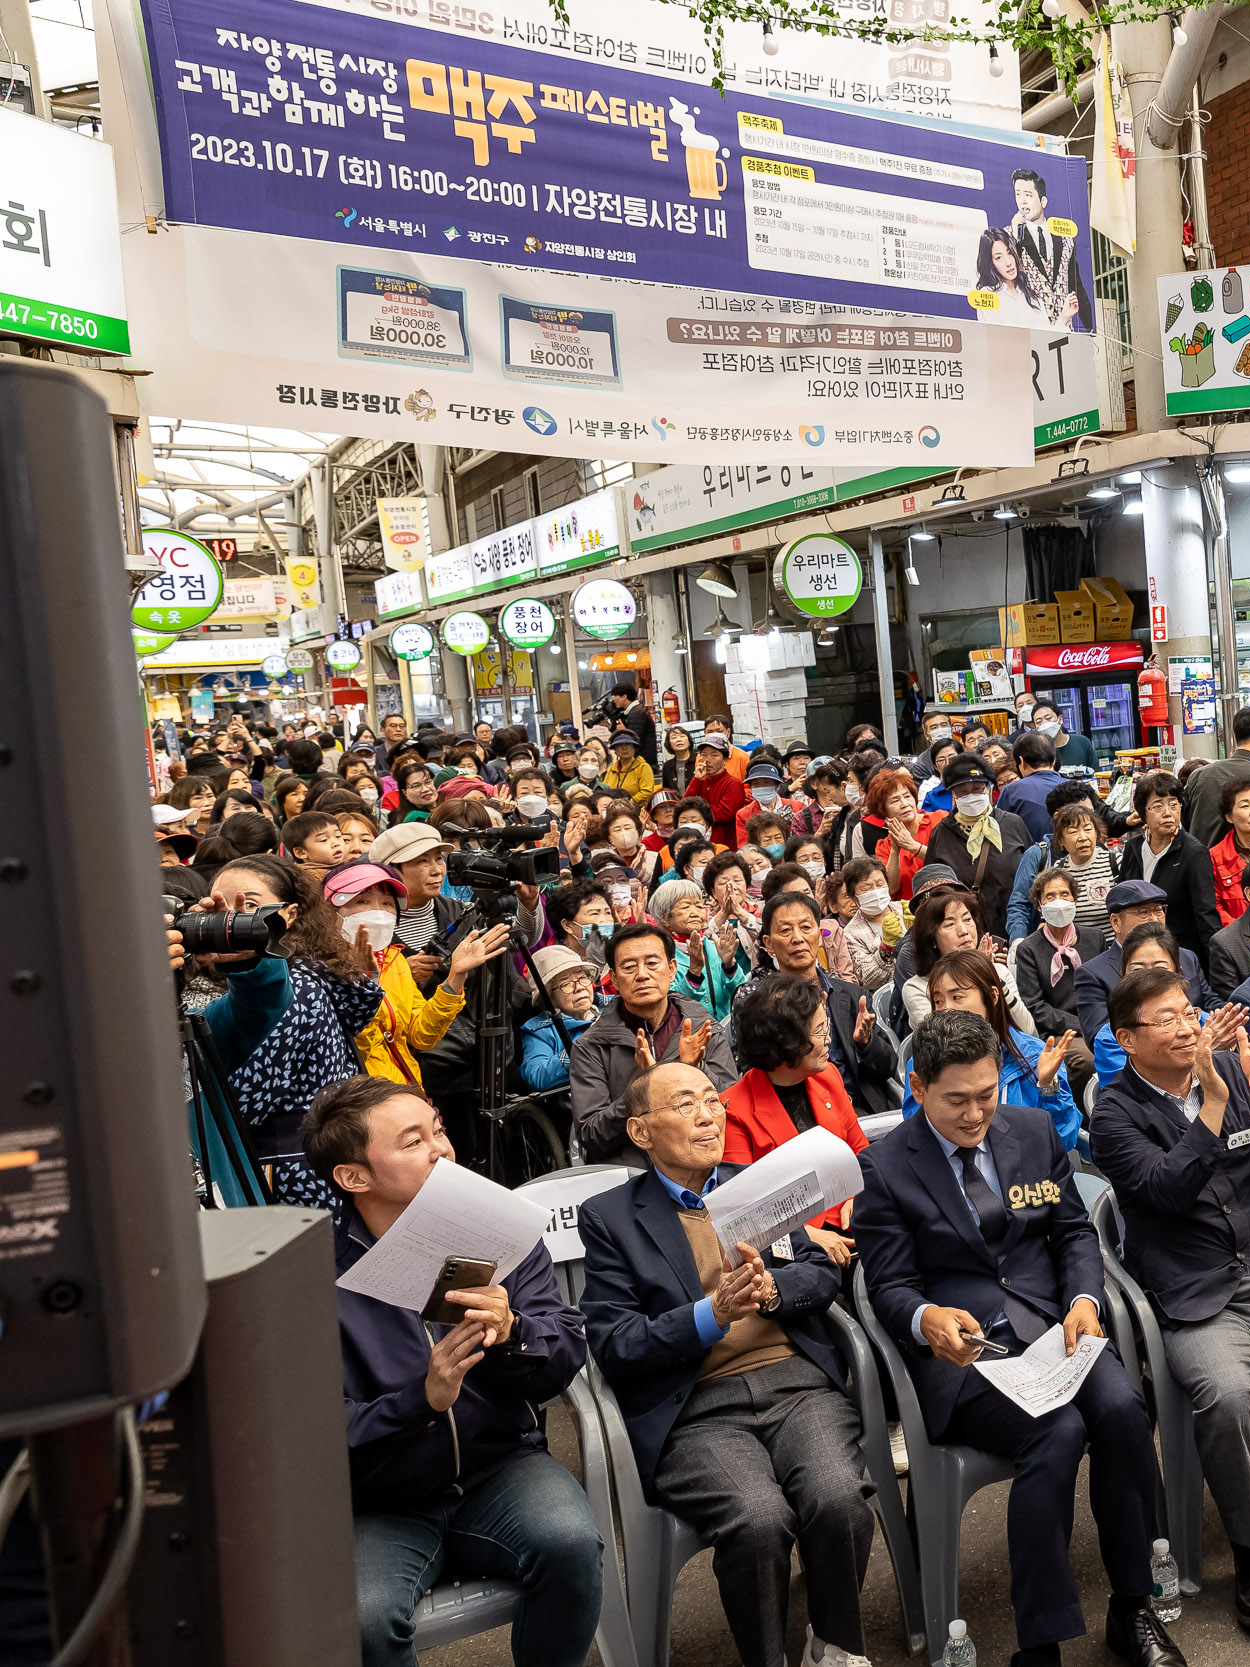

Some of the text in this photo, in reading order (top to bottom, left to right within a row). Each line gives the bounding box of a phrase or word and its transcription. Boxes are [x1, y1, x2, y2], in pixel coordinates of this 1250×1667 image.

[215, 28, 398, 96] 자양 전통 시장
[174, 59, 406, 142] 고객과 함께 하는
[405, 58, 669, 167] 맥주 페스티벌
[743, 115, 778, 132] 맥주축제
[744, 133, 775, 148] 행사기간
[776, 139, 784, 149] 내
[785, 141, 800, 153] 시장
[801, 143, 833, 159] 1만원이상
[879, 157, 903, 171] 맥주1잔
[903, 162, 918, 173] 무료
[919, 165, 933, 176] 증정
[746, 159, 810, 180] 경품추첨 이벤트
[190, 133, 727, 239] 2023.10.17 (화) 16:00~20:00 자양전통시장 내
[751, 178, 781, 192] 응모 방법
[752, 189, 780, 202] 행사기간
[780, 193, 788, 204] 내
[789, 195, 797, 204] 각
[797, 196, 824, 209] 점포에서
[824, 200, 855, 214] 3만원이상
[855, 205, 874, 216] 구매시
[905, 214, 918, 224] 증정
[753, 205, 782, 218] 응모 기간
[0, 200, 51, 267] 회
[358, 216, 427, 239] 서울특별시
[466, 230, 510, 246] 광진구
[753, 217, 776, 229] 2023년
[777, 220, 791, 231] 10월
[791, 222, 805, 233] 15일
[812, 225, 825, 236] 10월
[826, 227, 839, 238] 17일
[860, 232, 873, 242] 까지
[755, 233, 769, 243] 추첨
[882, 225, 907, 237] 경품안내
[544, 240, 637, 264] 자양전통시장 상인회
[755, 244, 778, 256] 2023년
[779, 247, 792, 257] 10월
[793, 249, 806, 260] 17일
[842, 256, 856, 266] 수시
[974, 299, 994, 308] 노현지
[1046, 417, 1089, 440] T.444-0772
[393, 535, 417, 543] OPEN
[143, 546, 190, 568] YC
[487, 543, 501, 573] 자양
[502, 537, 516, 568] 풍천
[518, 529, 534, 563] 장어
[792, 553, 850, 572] 우리마트
[140, 574, 206, 601] 영점
[808, 573, 838, 592] 생선
[513, 605, 542, 619] 풍천
[816, 599, 834, 610] 생선
[149, 610, 182, 625] 속옷
[515, 620, 543, 634] 장어
[1058, 646, 1111, 668] Coca-Cola
[1008, 1179, 1061, 1210] 오신환
